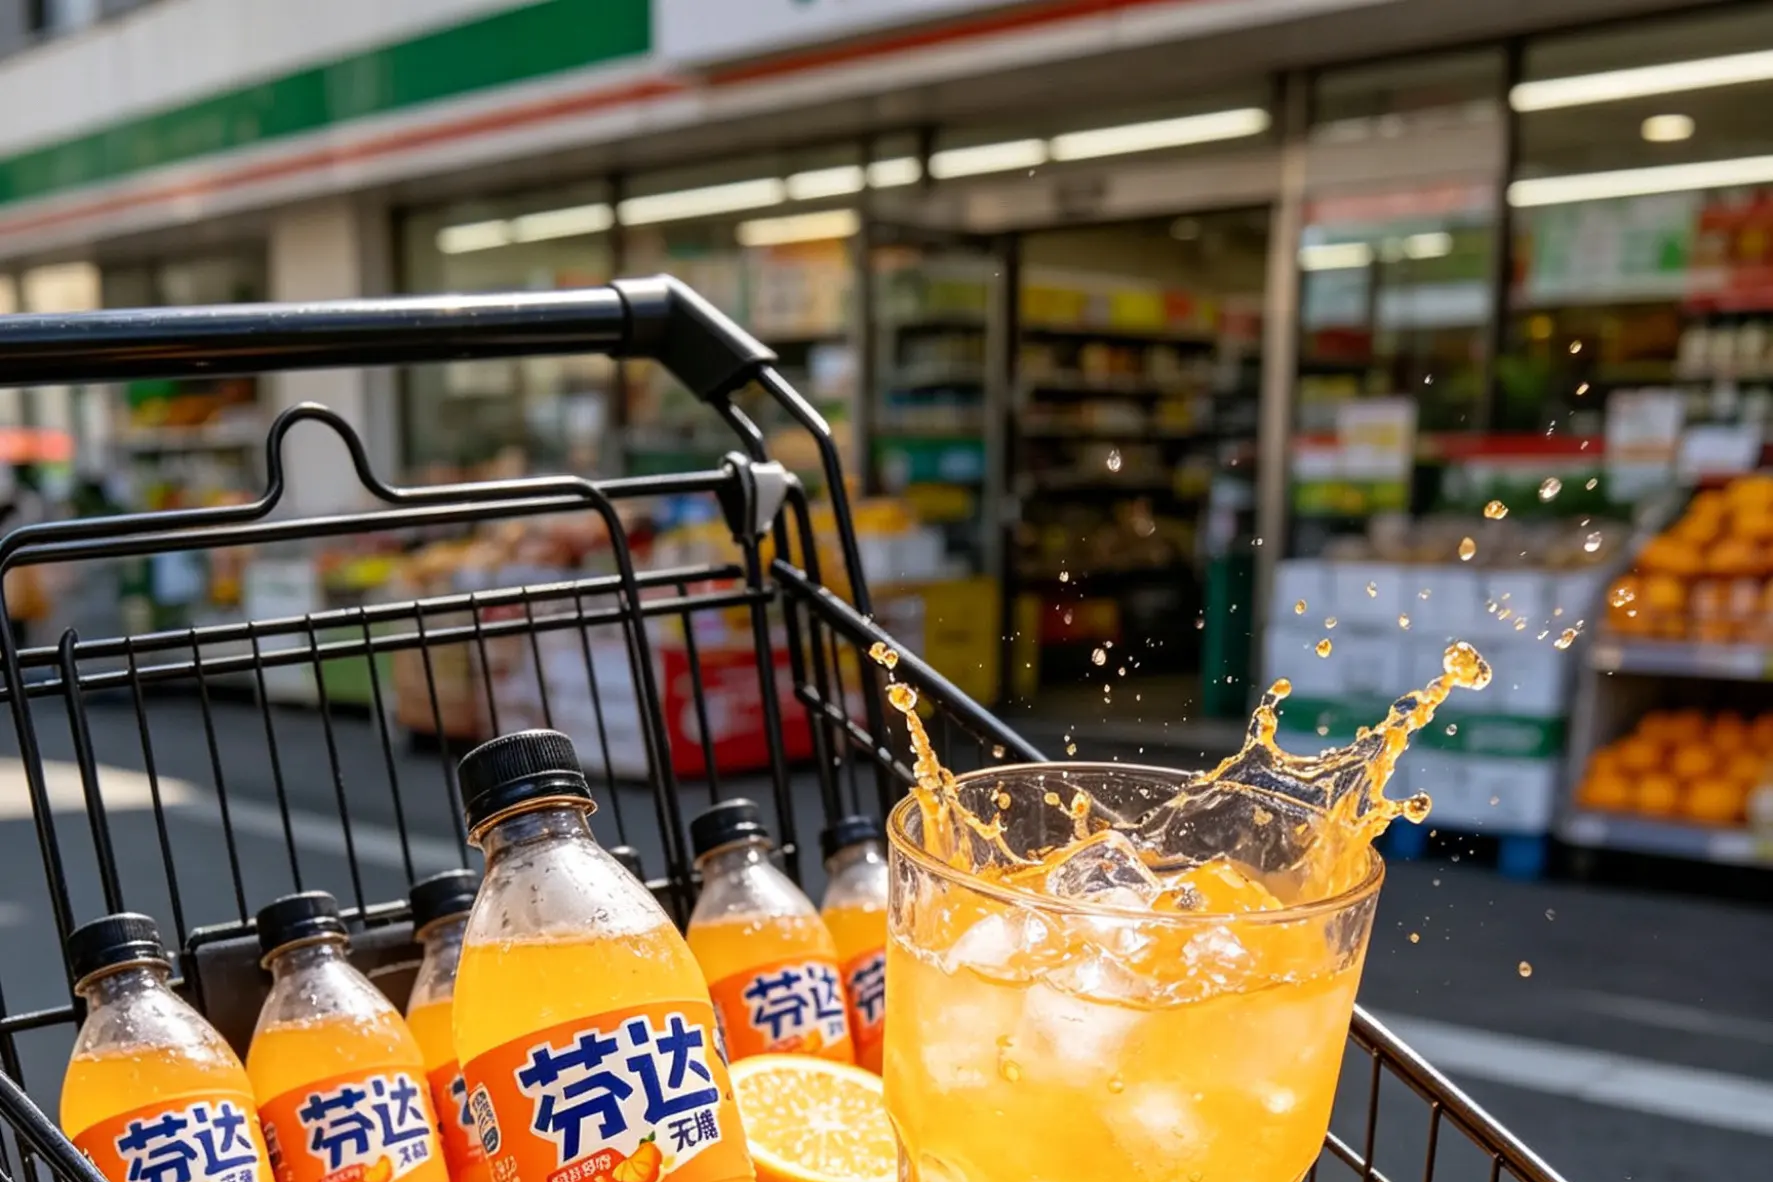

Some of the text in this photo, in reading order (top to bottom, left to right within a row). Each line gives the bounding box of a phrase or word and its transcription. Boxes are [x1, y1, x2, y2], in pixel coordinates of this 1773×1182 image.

[745, 966, 843, 1039] 芬达
[300, 1077, 430, 1170] 芬达
[518, 1017, 718, 1161] 芬达
